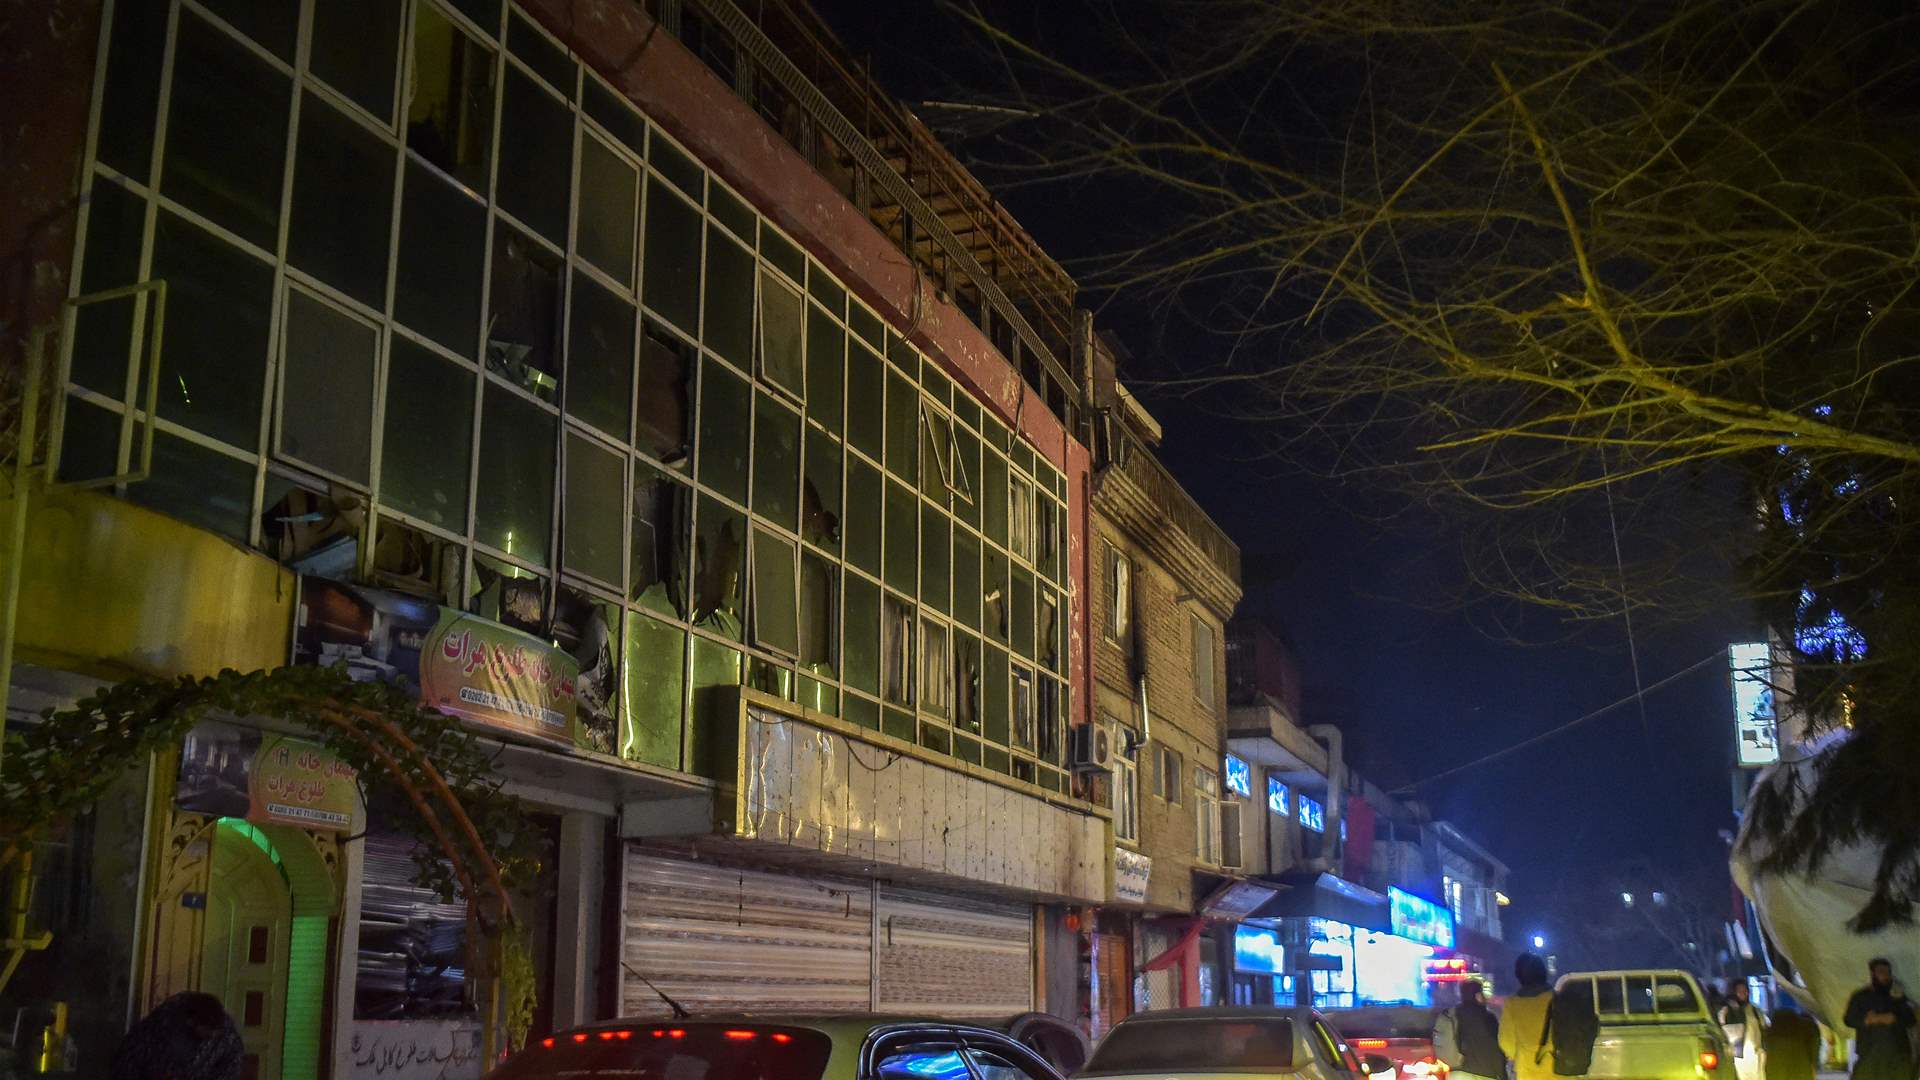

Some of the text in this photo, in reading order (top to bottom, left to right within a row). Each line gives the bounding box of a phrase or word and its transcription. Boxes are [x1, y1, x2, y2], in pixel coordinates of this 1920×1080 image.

[442, 628, 487, 677] هرات
[296, 751, 321, 771] خانه
[268, 775, 325, 802] طلوع هرات
